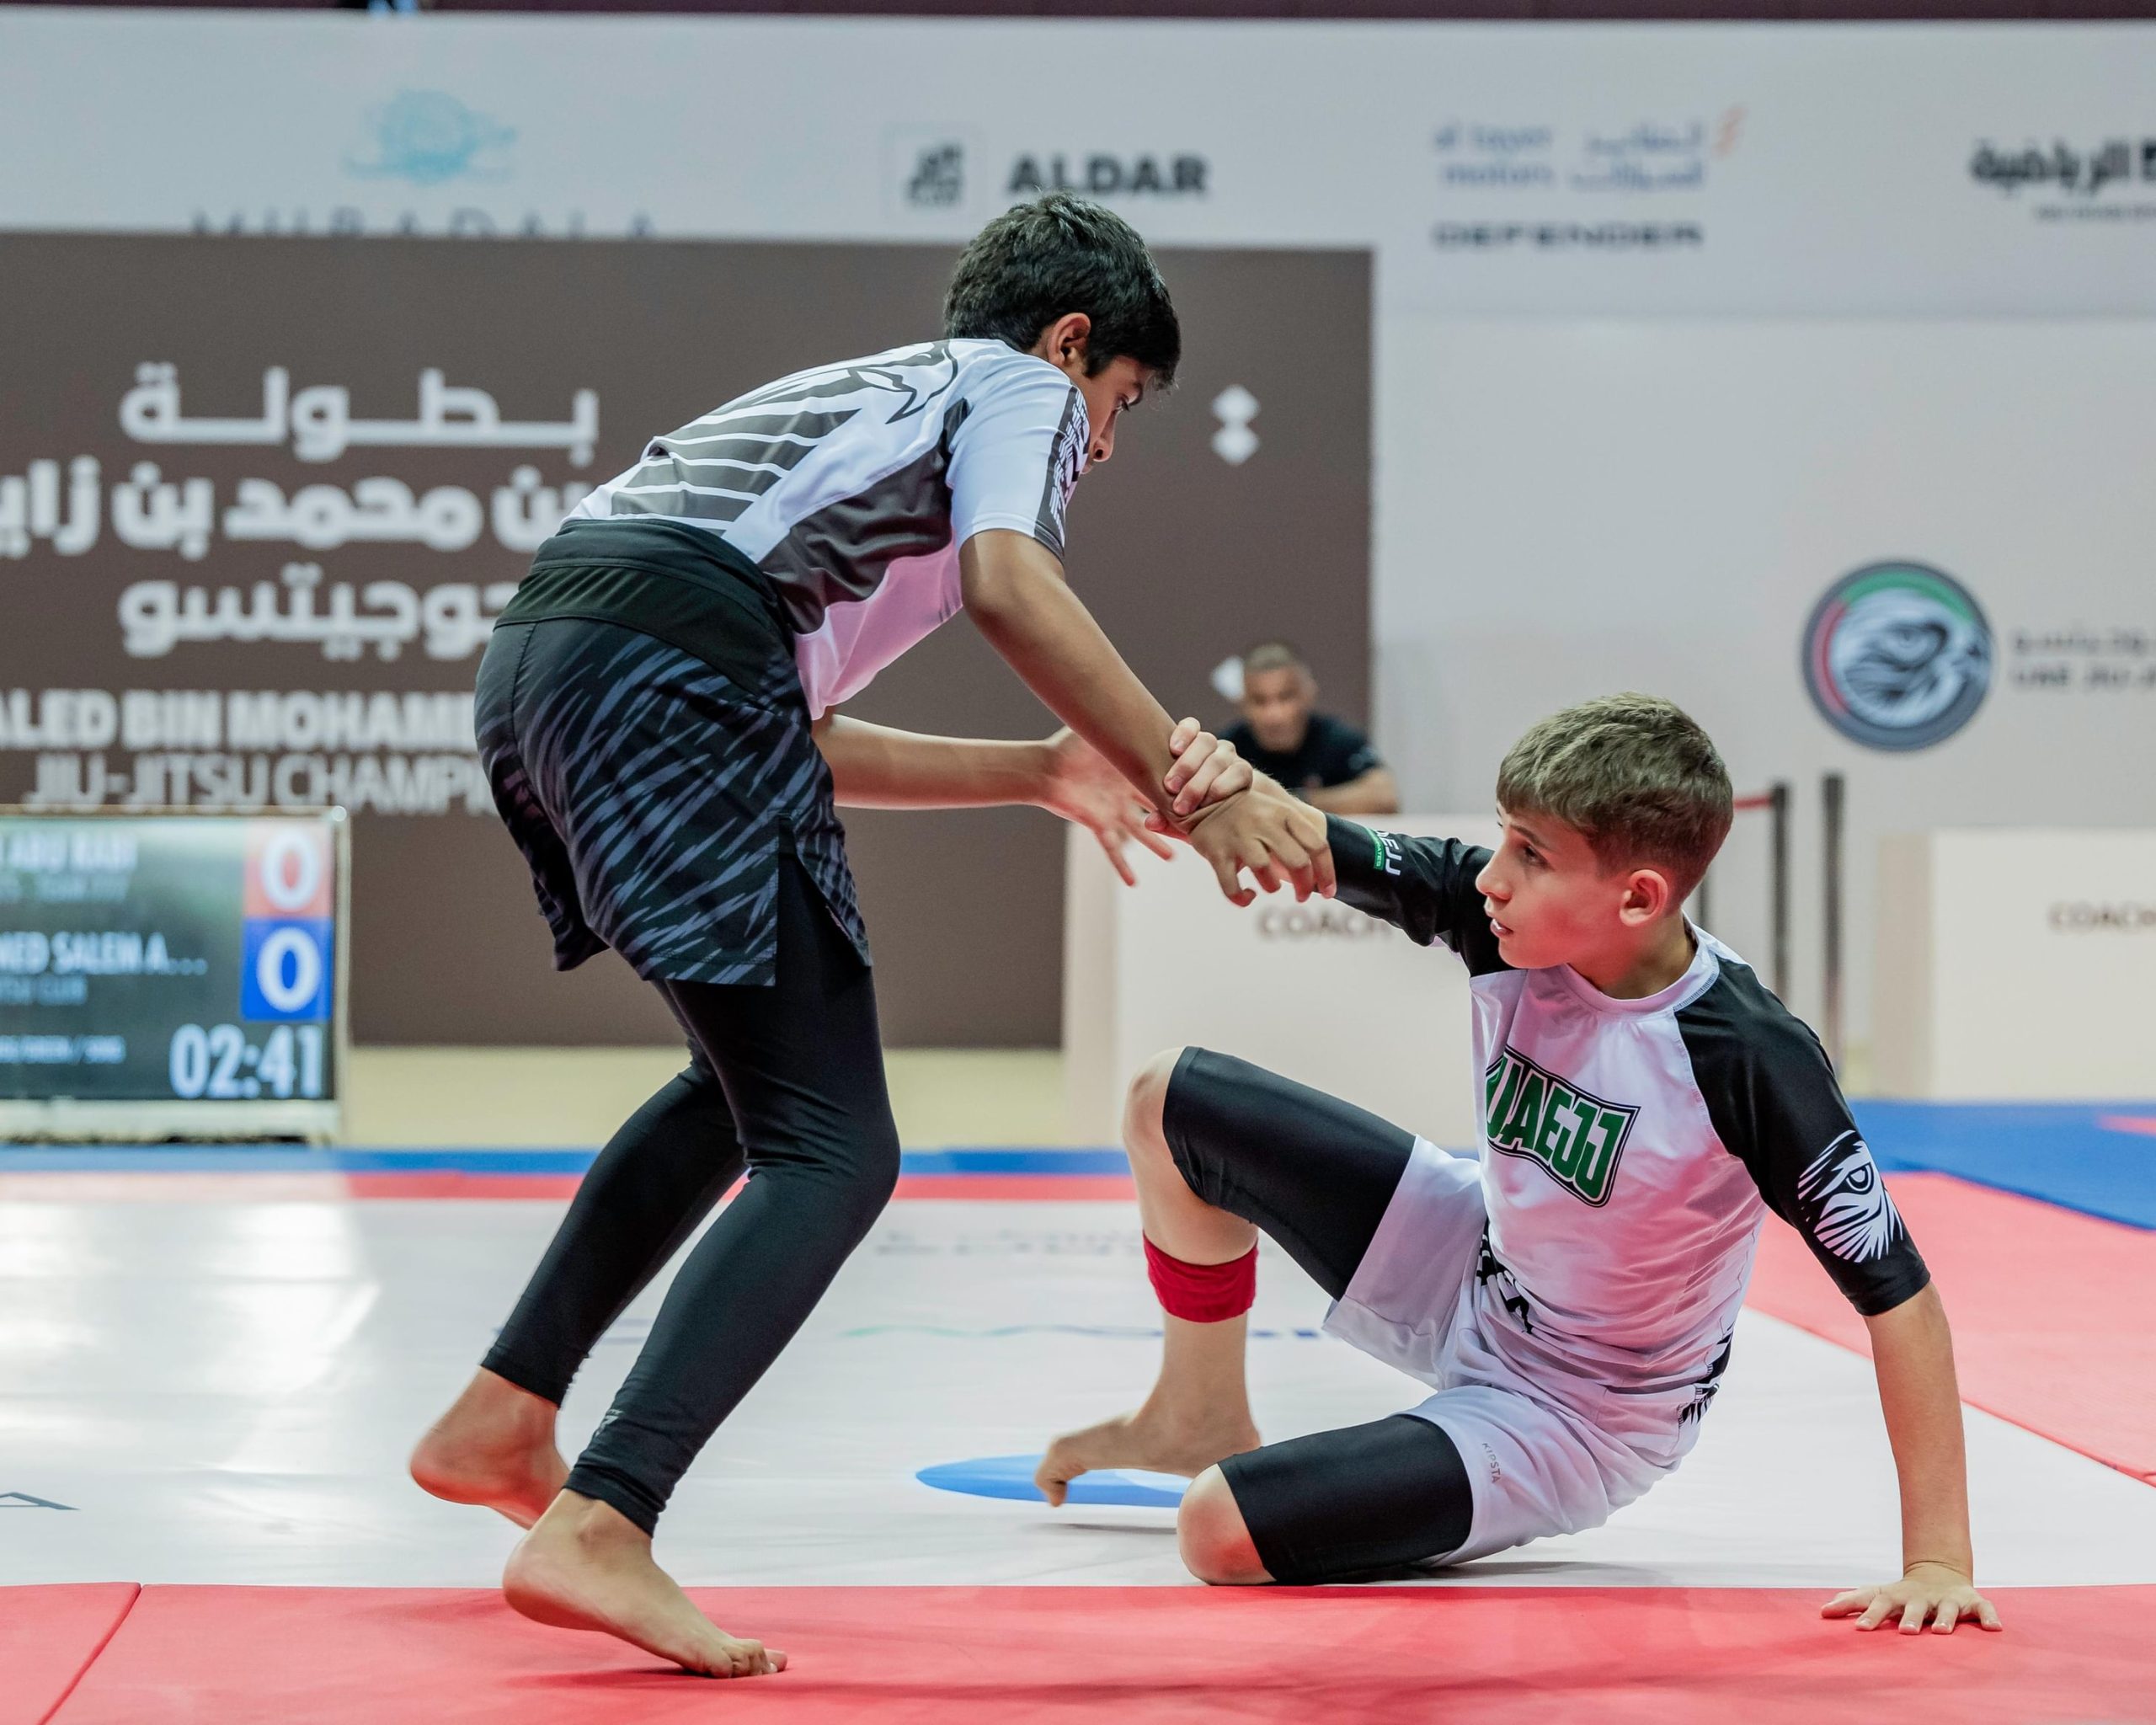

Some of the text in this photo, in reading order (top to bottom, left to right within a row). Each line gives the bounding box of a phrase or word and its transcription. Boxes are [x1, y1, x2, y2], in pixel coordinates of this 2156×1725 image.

[1007, 152, 1212, 195] ALDAR
[119, 362, 600, 467] بطولة
[112, 461, 215, 561] بن
[224, 476, 484, 552] محمد
[122, 689, 222, 751] BIN
[23, 752, 271, 813] JIU-JITSU
[262, 828, 322, 912] 0
[256, 927, 322, 1013] 0
[170, 1023, 323, 1099] 02:41
